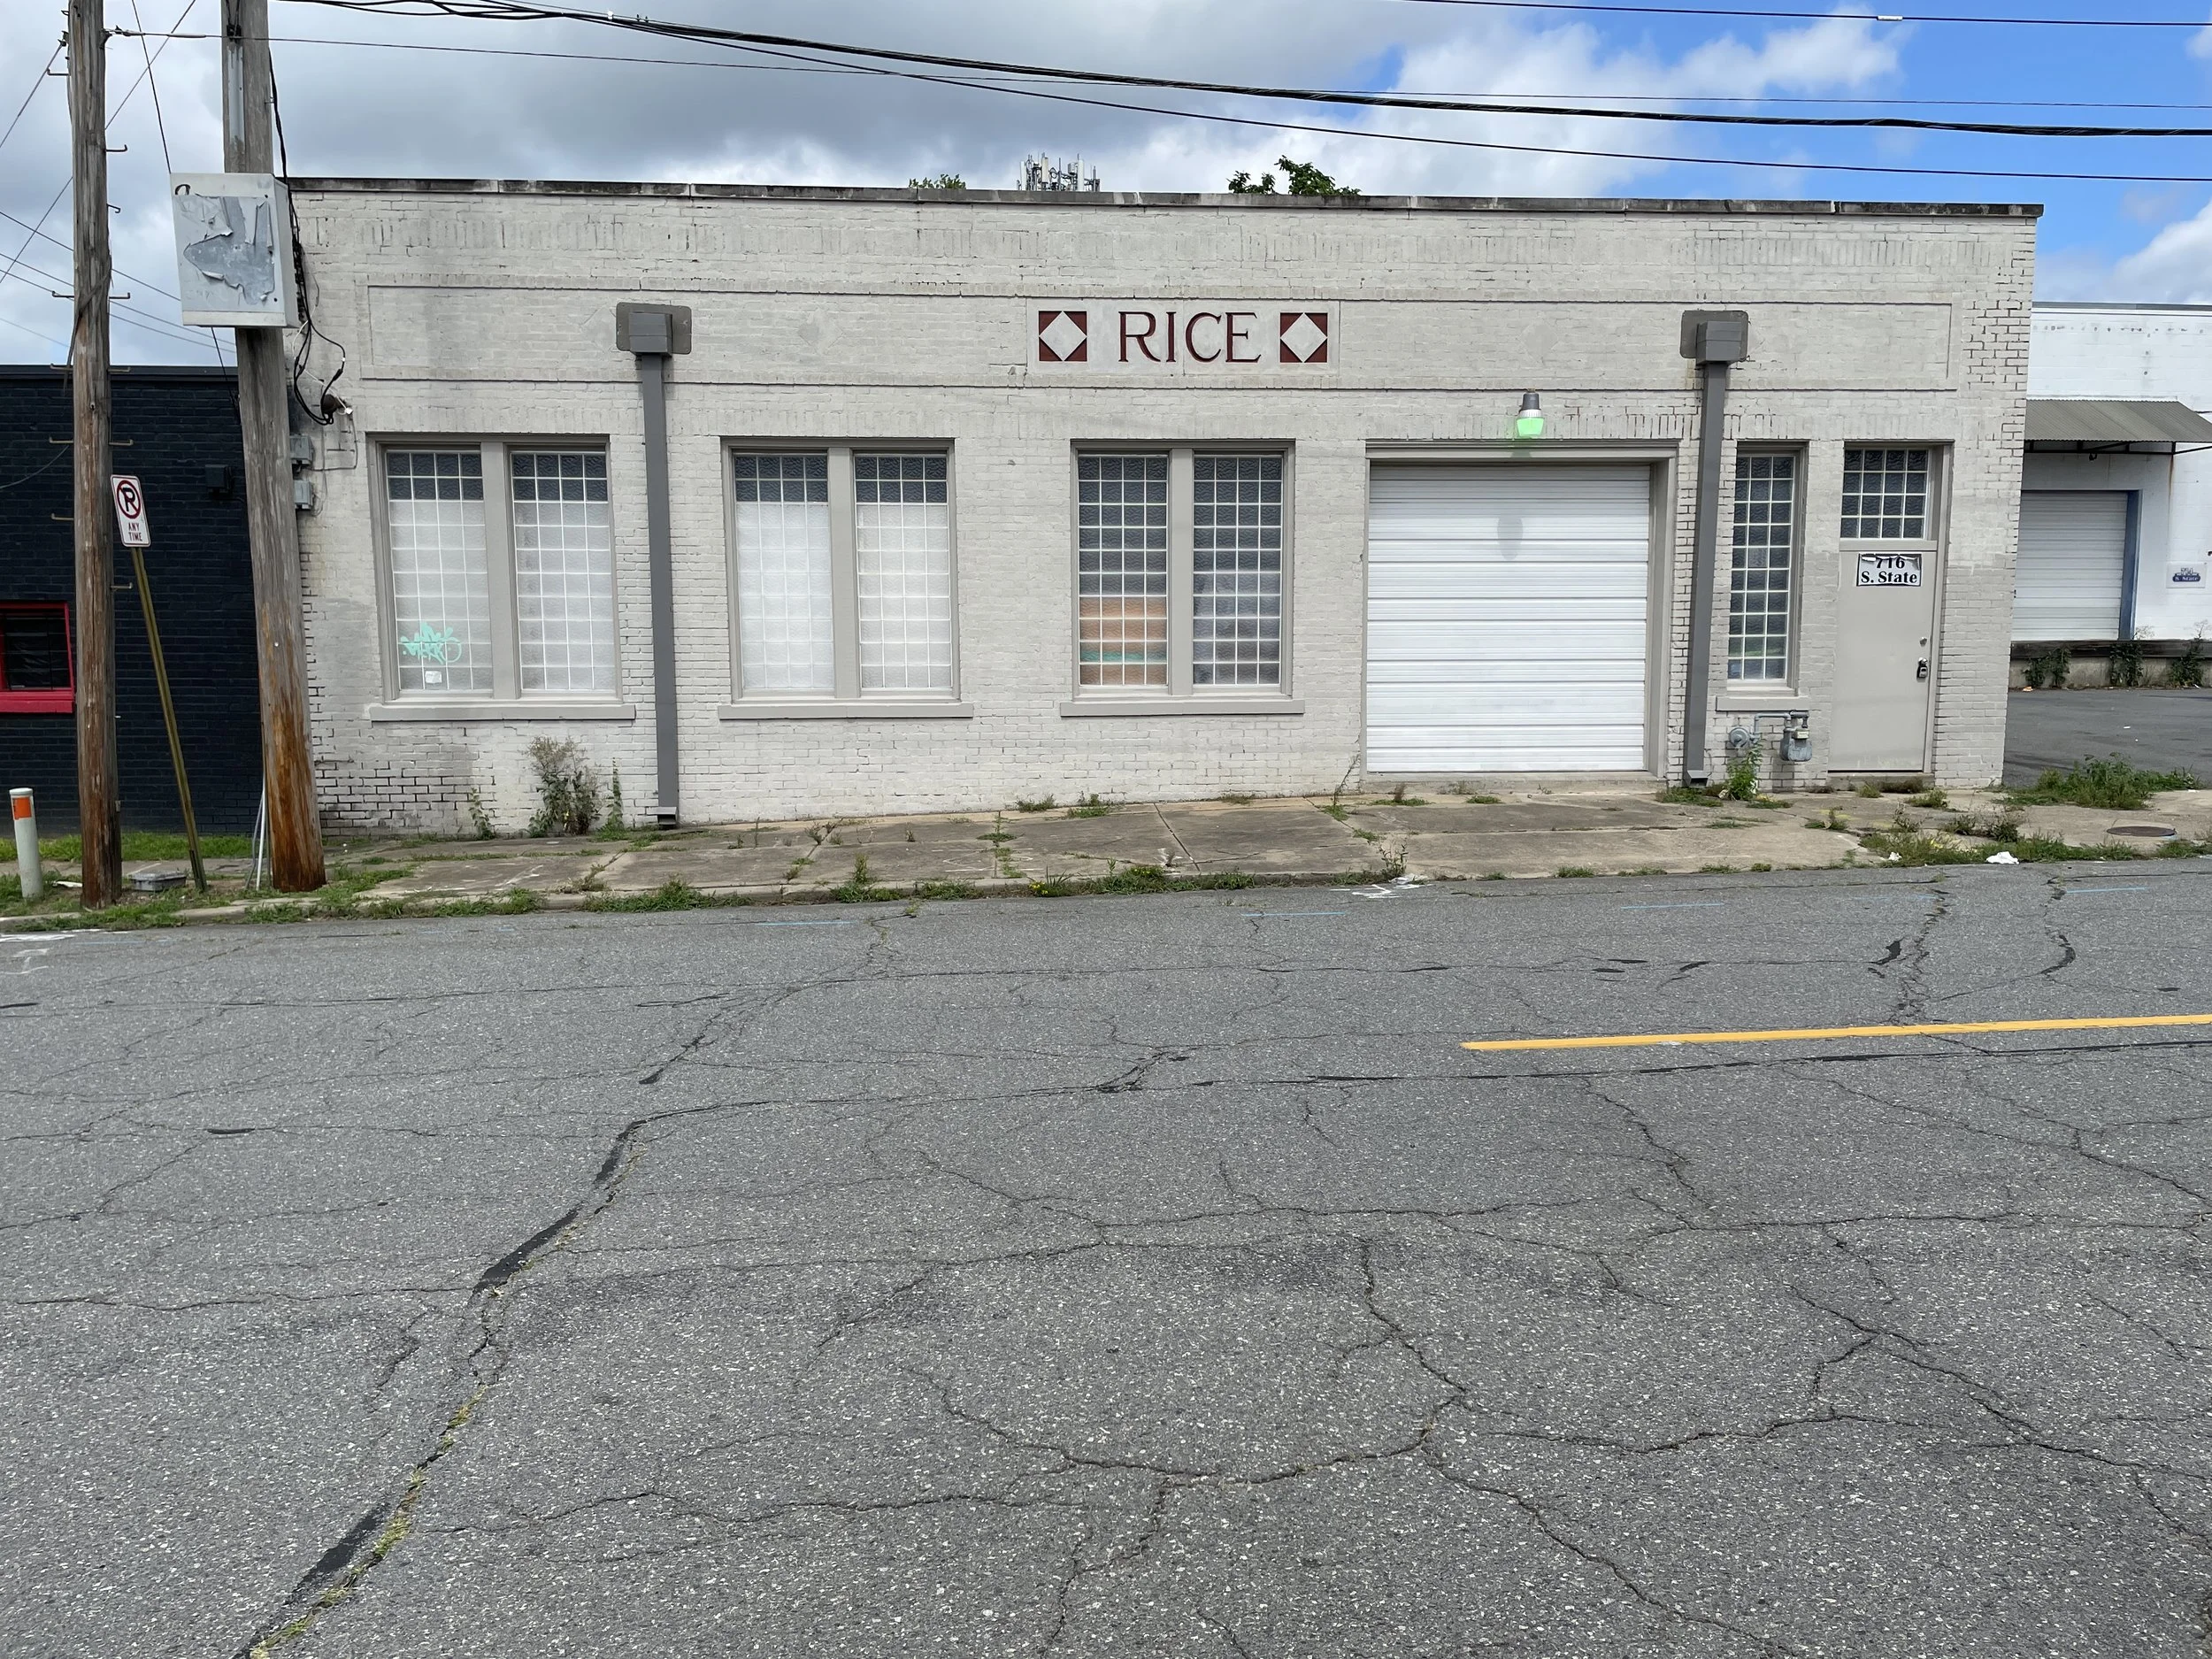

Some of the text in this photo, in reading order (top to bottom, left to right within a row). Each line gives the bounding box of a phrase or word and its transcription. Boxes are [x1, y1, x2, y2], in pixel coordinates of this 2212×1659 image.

[1118, 311, 1263, 364] RICE
[128, 522, 140, 532] ANY
[128, 532, 142, 541] TIME
[1876, 557, 1905, 569] 716
[1861, 571, 1917, 583] S. State
